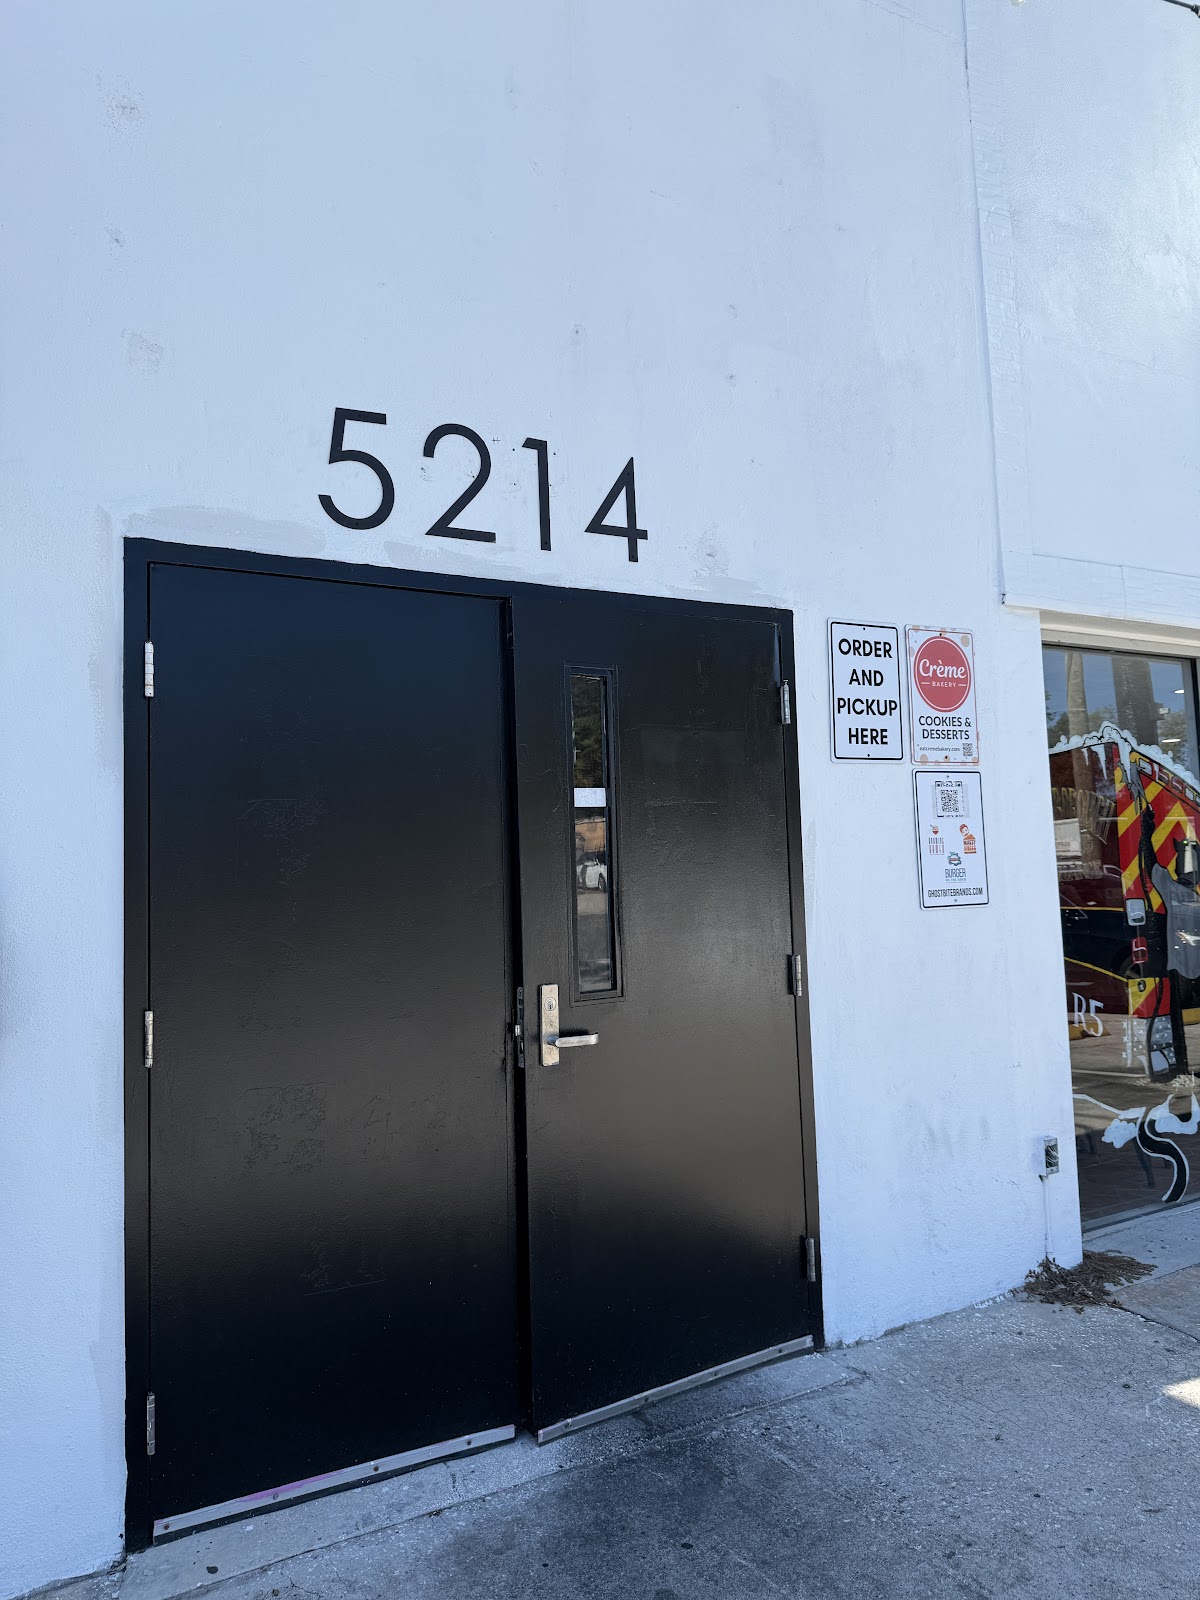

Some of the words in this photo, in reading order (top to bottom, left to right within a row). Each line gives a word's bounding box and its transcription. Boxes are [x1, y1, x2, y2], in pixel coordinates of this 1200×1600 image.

[318, 407, 648, 562] 5214
[838, 638, 893, 659] ORDER
[919, 658, 967, 679] Crème
[849, 669, 884, 687] AND
[837, 697, 898, 716] PICKUP
[918, 715, 963, 728] COOKIES
[964, 718, 972, 728] &
[848, 728, 888, 745] HERE
[922, 728, 970, 740] DESSERTS
[945, 868, 966, 878] BURGER
[1072, 992, 1104, 1037] R5
